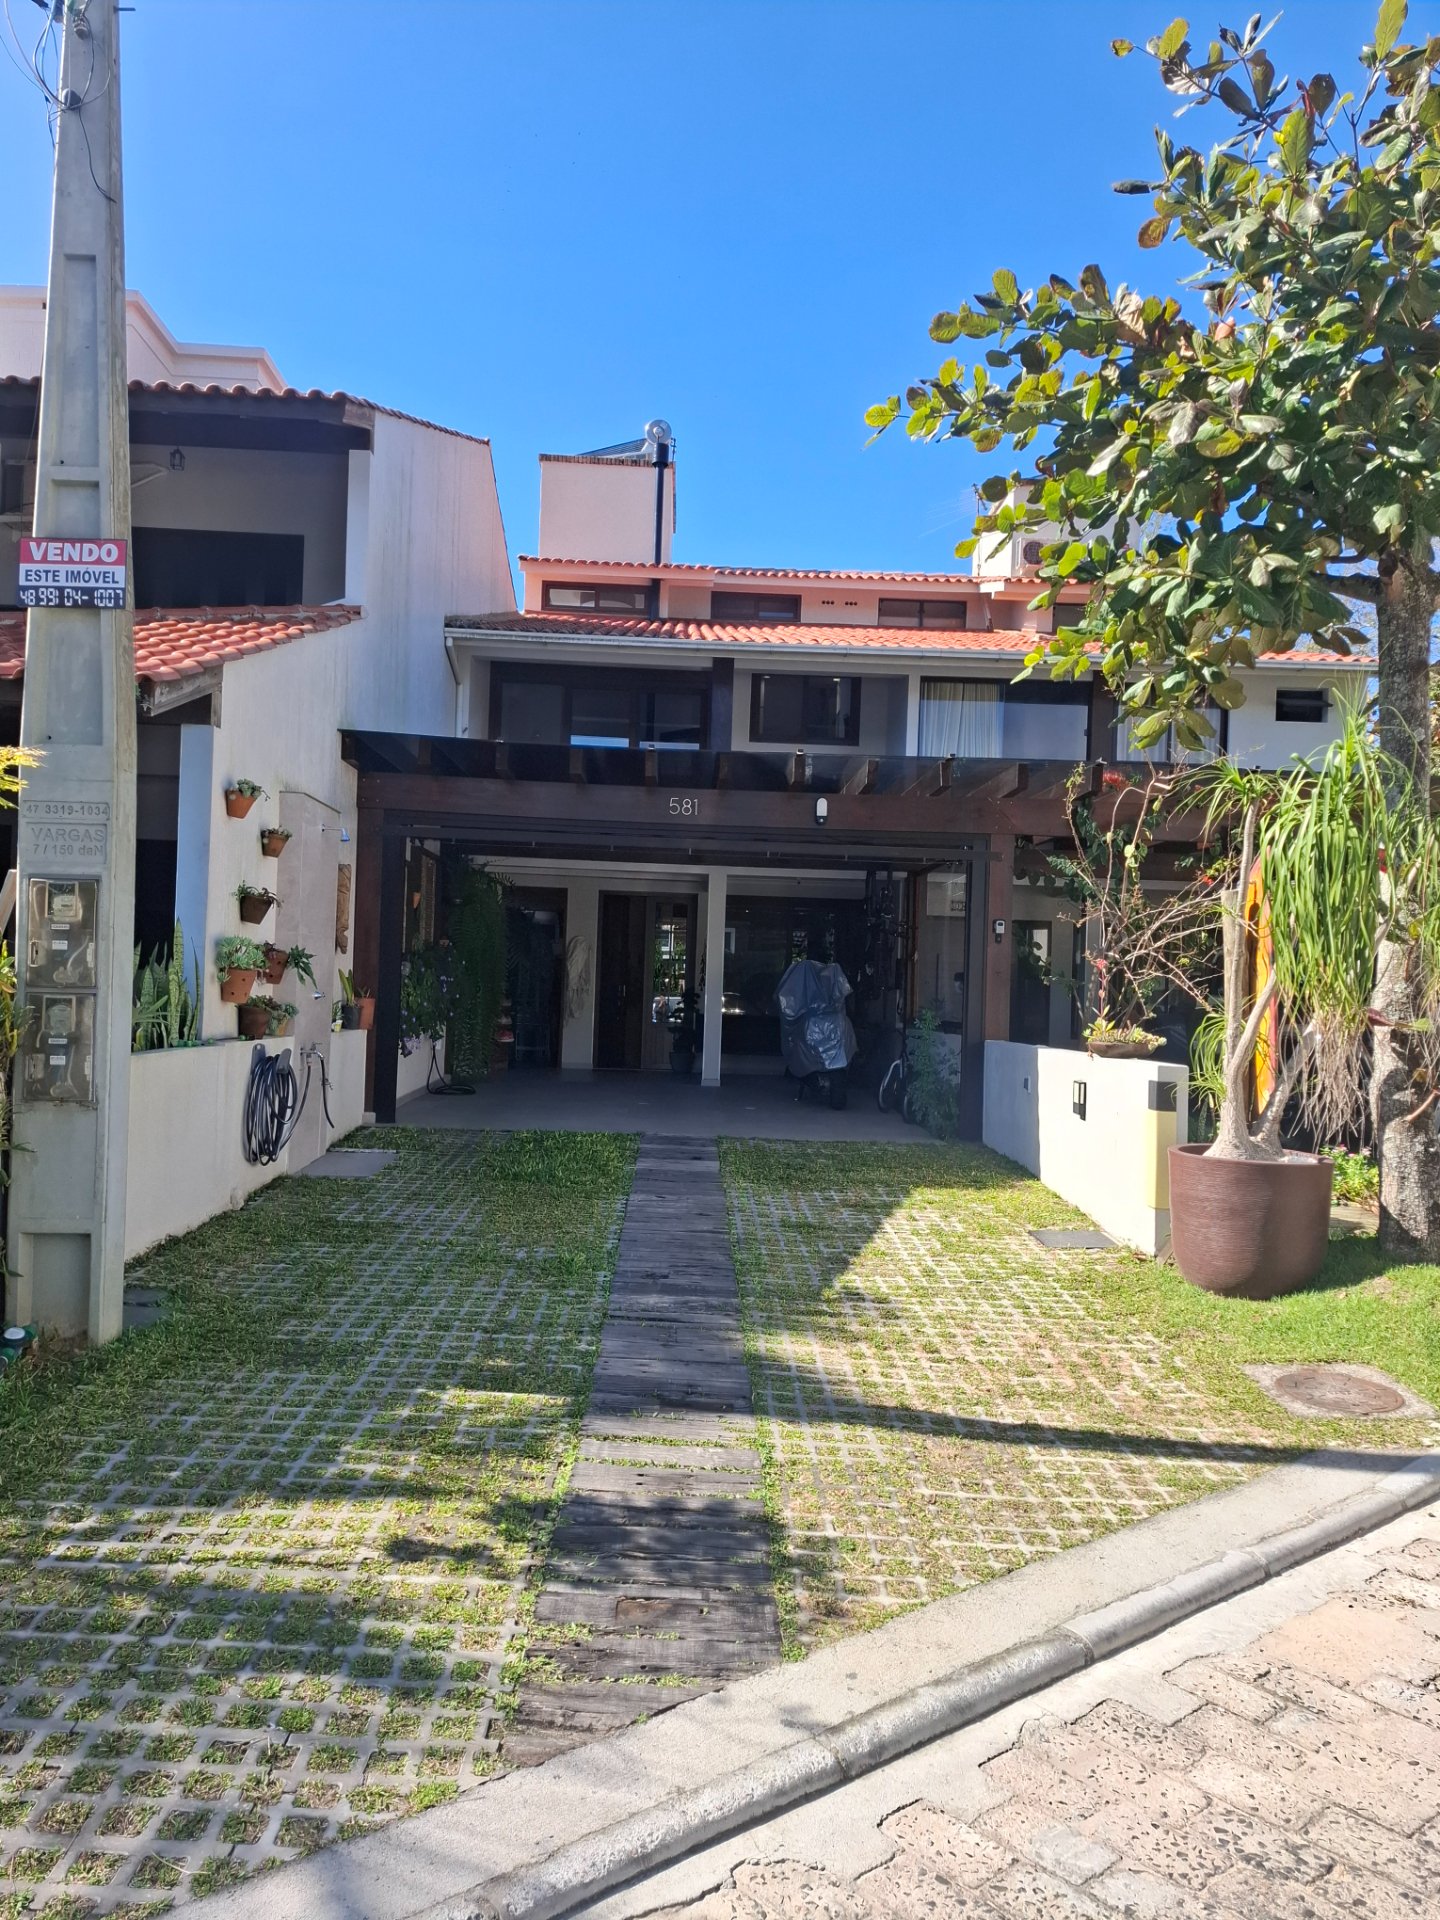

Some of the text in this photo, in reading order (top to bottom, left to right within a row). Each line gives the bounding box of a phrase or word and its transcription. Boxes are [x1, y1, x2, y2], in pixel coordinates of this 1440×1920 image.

[29, 541, 119, 563] VENDO
[24, 567, 120, 584] ESTE IMÓVEL
[20, 589, 36, 606] 48
[26, 804, 109, 816] 47 3319-1034
[669, 797, 699, 816] 581
[31, 827, 105, 843] VARGAS
